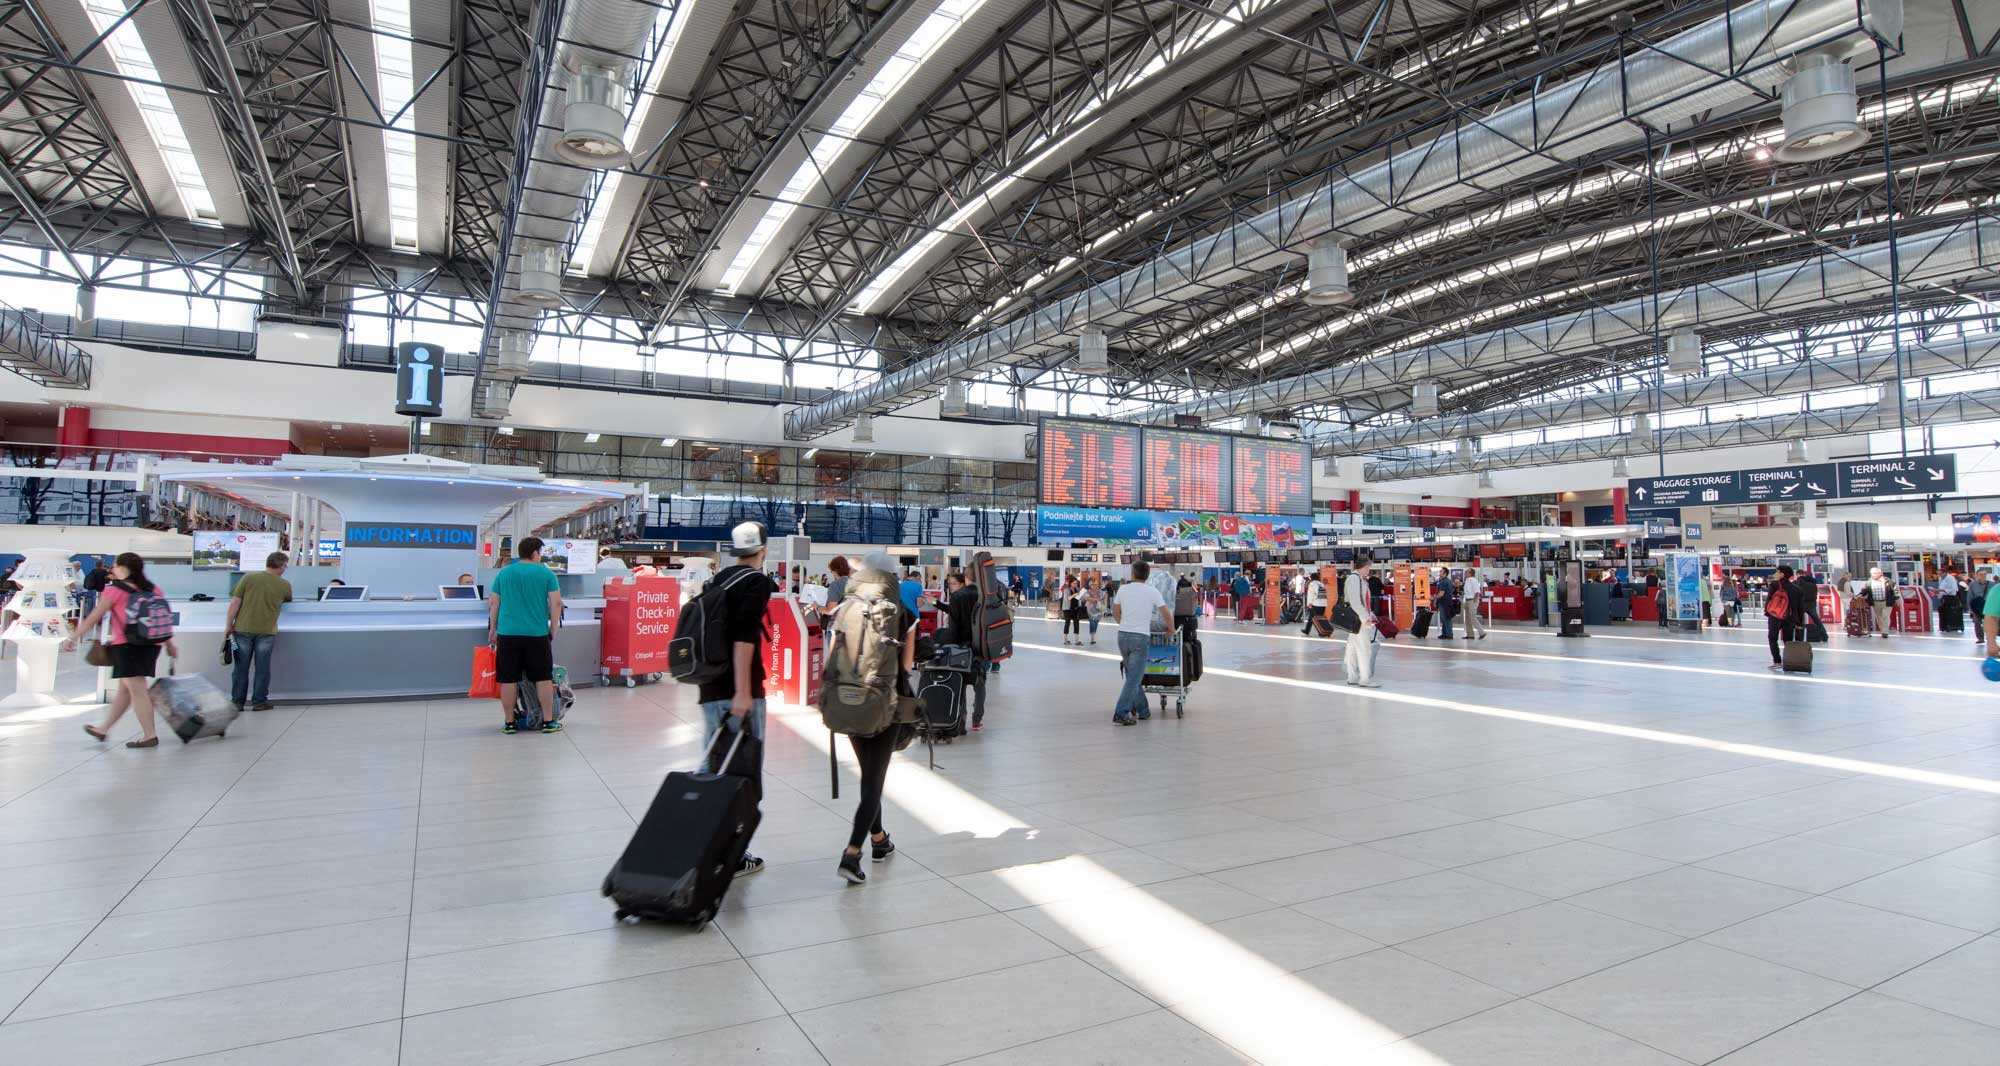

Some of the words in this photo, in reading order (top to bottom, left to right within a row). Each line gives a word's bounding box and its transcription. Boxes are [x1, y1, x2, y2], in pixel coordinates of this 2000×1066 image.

[1850, 462, 1905, 474] TERMINAL
[1907, 461, 1915, 470] 2
[1653, 479, 1690, 489] BAGGAGE
[1692, 475, 1732, 486] STORAGE
[1748, 471, 1796, 482] TERMINAL
[1798, 470, 1803, 478] 1
[1043, 510, 1084, 522] Podnikejte
[1085, 512, 1099, 521] bez
[1101, 514, 1125, 523] hranic.
[348, 527, 474, 545] INFORMATION
[1137, 528, 1149, 537] citi
[637, 591, 669, 603] Private
[636, 606, 675, 619] Check-in
[636, 622, 669, 635] Service
[771, 623, 781, 651] Prague
[771, 653, 779, 670] from
[770, 673, 780, 685] Fly
